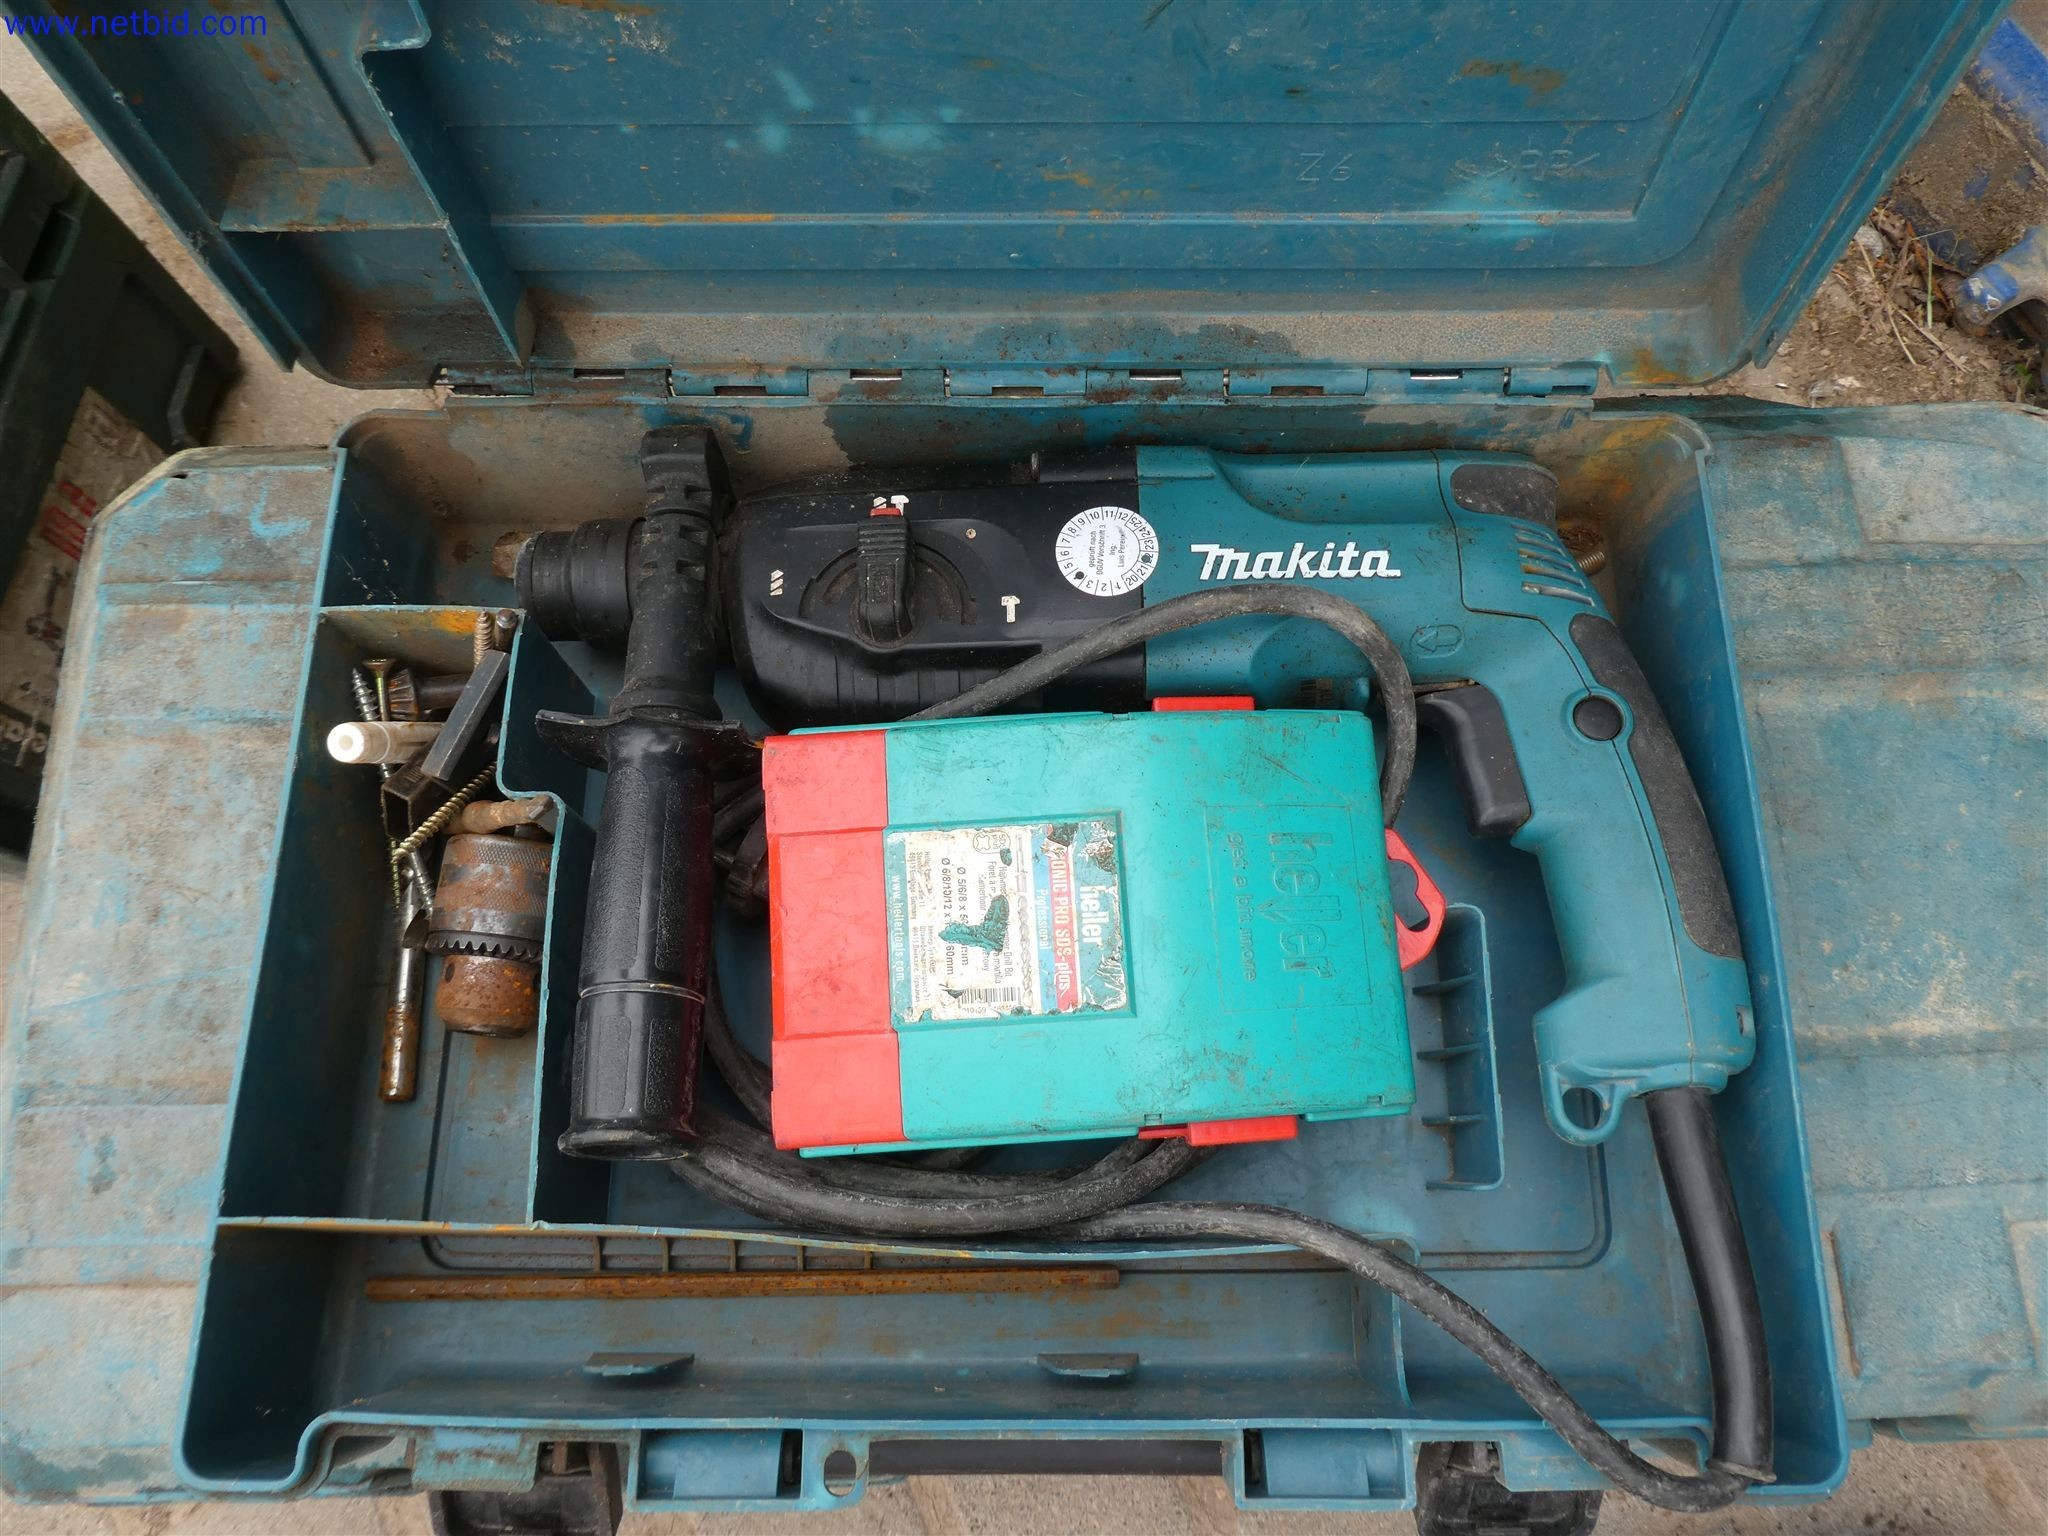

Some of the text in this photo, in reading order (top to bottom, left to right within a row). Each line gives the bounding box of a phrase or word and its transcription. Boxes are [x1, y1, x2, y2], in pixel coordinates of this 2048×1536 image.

[1089, 511, 1100, 520] 10
[1118, 512, 1128, 521] 12
[1129, 517, 1141, 527] 25
[1144, 540, 1154, 550] 23
[1137, 565, 1149, 576] 21
[1125, 575, 1139, 586] 20
[1101, 583, 1107, 591] 2
[958, 878, 967, 902] 5/6/8
[1054, 897, 1069, 924] PRO
[1227, 832, 1257, 982] get a bit more
[1081, 885, 1110, 947] heller
[893, 874, 905, 982] www.hellertools.com
[1055, 929, 1072, 990] SDS-plus
